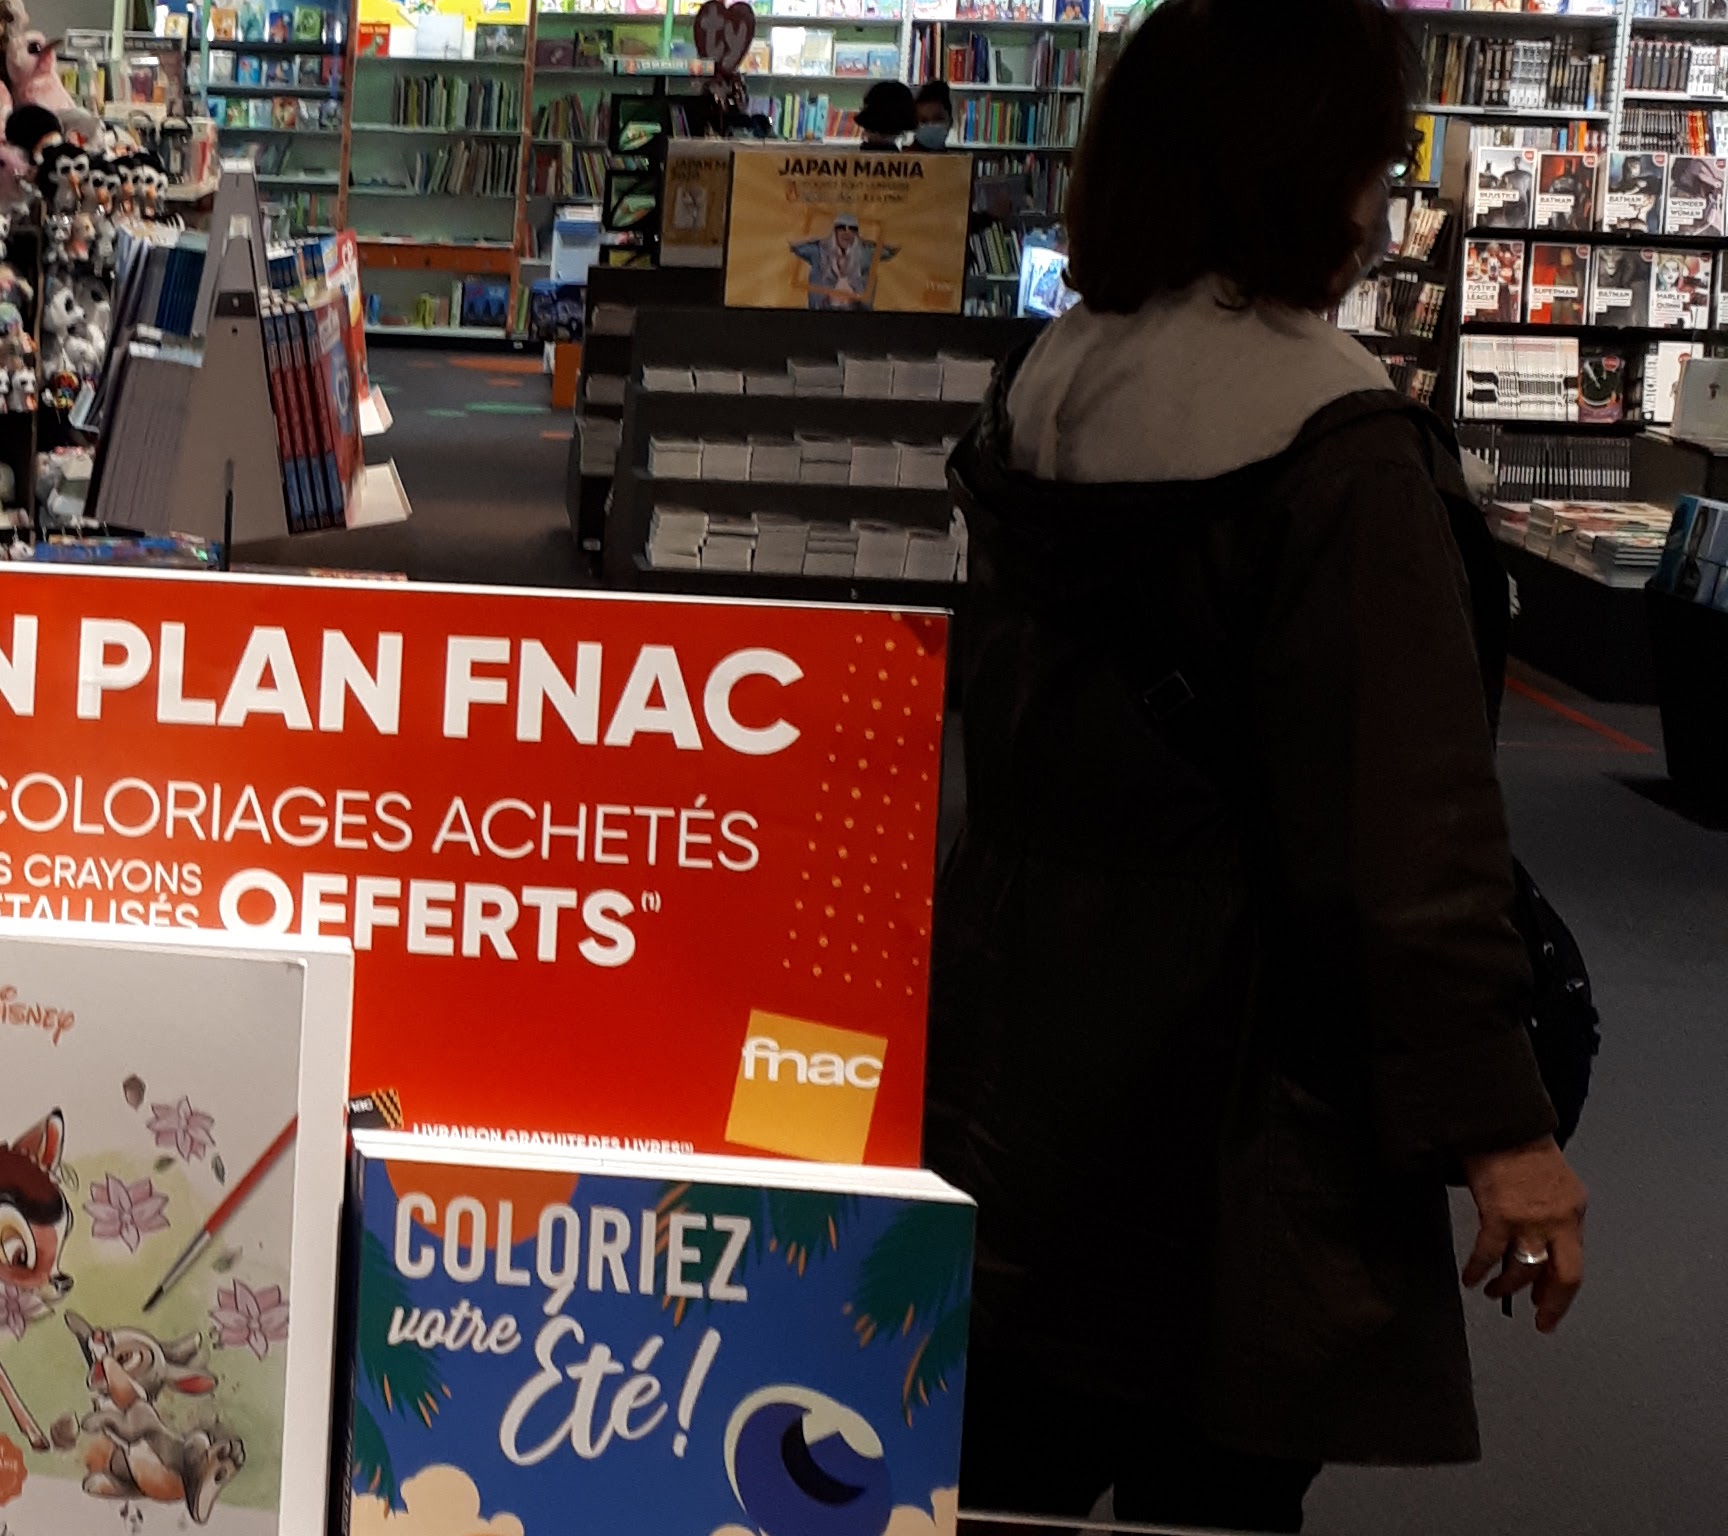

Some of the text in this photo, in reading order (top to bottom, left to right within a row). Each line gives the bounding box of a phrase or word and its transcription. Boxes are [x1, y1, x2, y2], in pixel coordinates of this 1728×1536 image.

[778, 157, 923, 179] JAPAN MANIA
[1539, 196, 1572, 204] BATMAN
[1598, 290, 1630, 298] BATMAN
[75, 616, 405, 738] PLAN
[441, 633, 807, 759] FNAC
[432, 793, 761, 873] ACHETÉS
[22, 852, 204, 897] CRAYONS
[740, 1035, 883, 1090] fnac
[393, 1191, 753, 1303] COLORIEZ
[387, 1301, 522, 1355] votre
